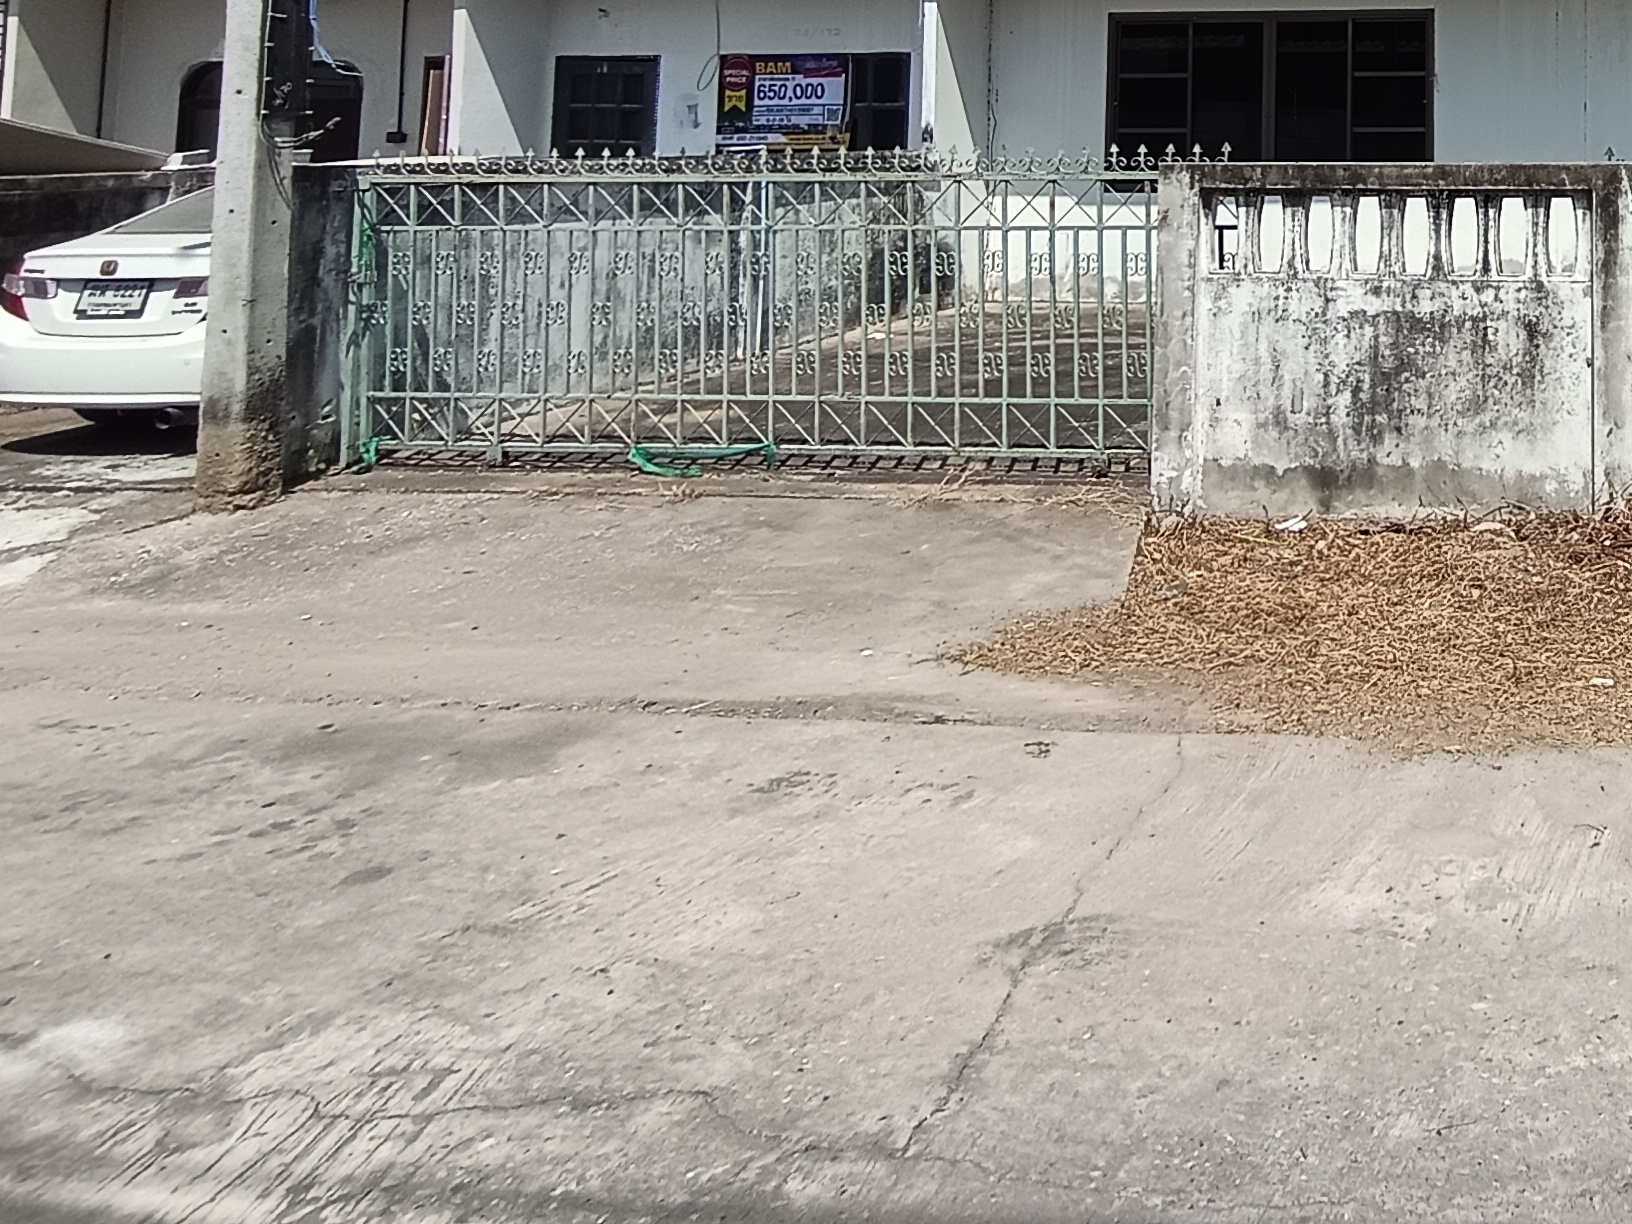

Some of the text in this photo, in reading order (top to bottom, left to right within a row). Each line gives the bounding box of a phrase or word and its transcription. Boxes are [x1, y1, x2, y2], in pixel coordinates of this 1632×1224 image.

[723, 68, 751, 76] SPECIAL
[755, 61, 792, 74] BAM
[756, 82, 826, 104] 650,000
